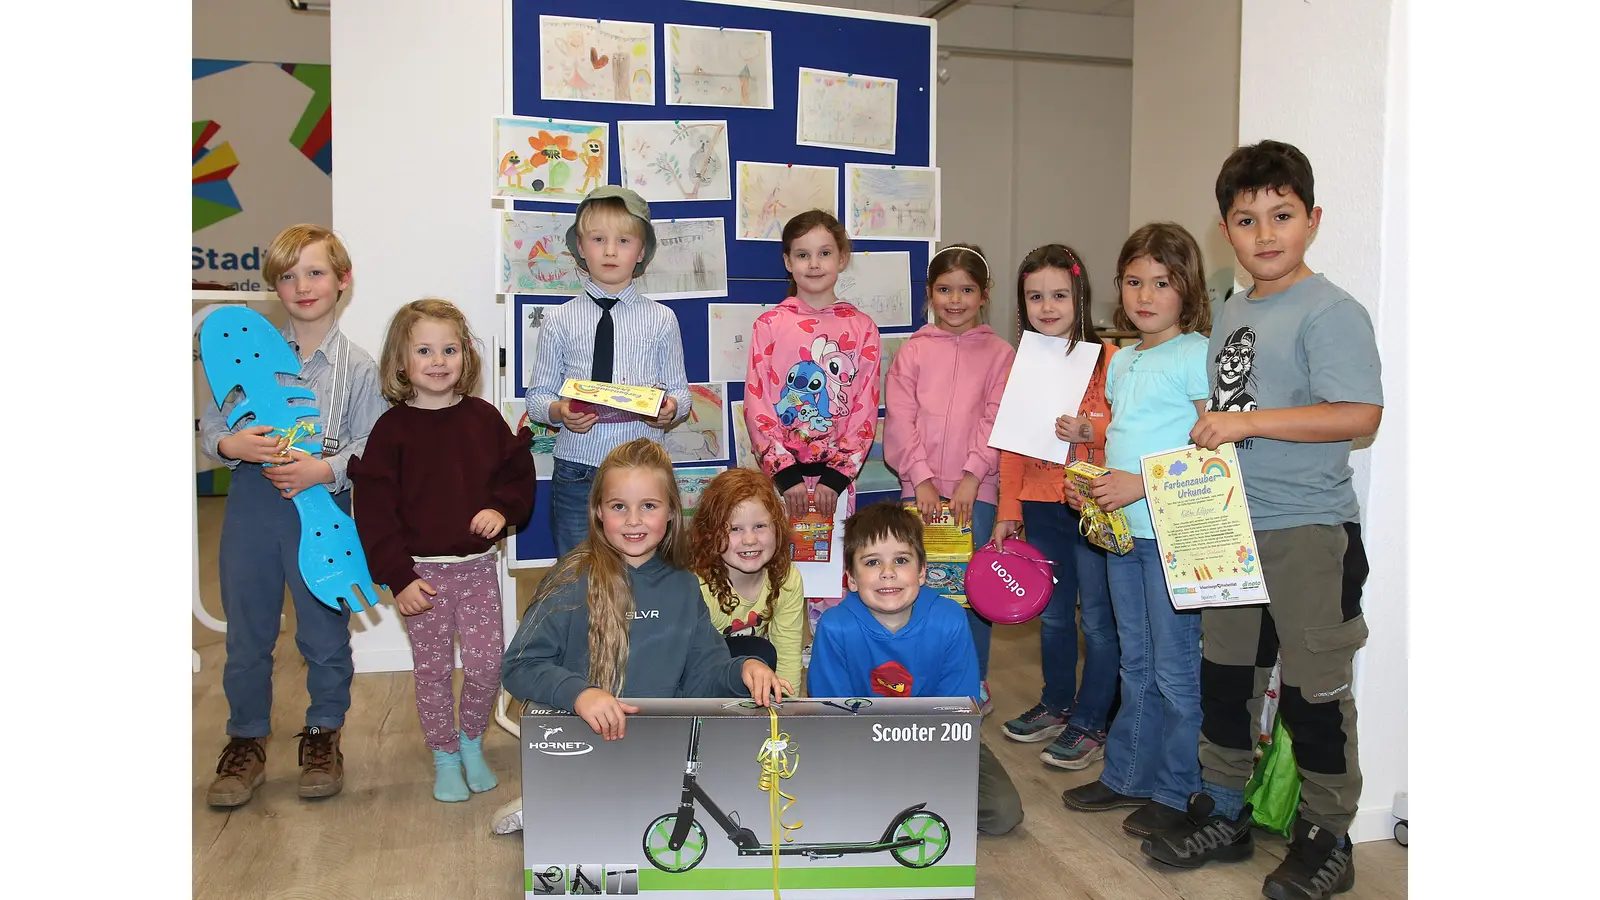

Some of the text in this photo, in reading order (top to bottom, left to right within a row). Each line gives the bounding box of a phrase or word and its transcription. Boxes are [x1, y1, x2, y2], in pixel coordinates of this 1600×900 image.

[1163, 474, 1221, 491] Farbenzauber
[1177, 486, 1212, 499] Urkunde
[931, 515, 949, 524] hr?
[990, 560, 1026, 597] oticon
[872, 722, 973, 742] Scooter 200
[529, 742, 584, 751] HORNET
